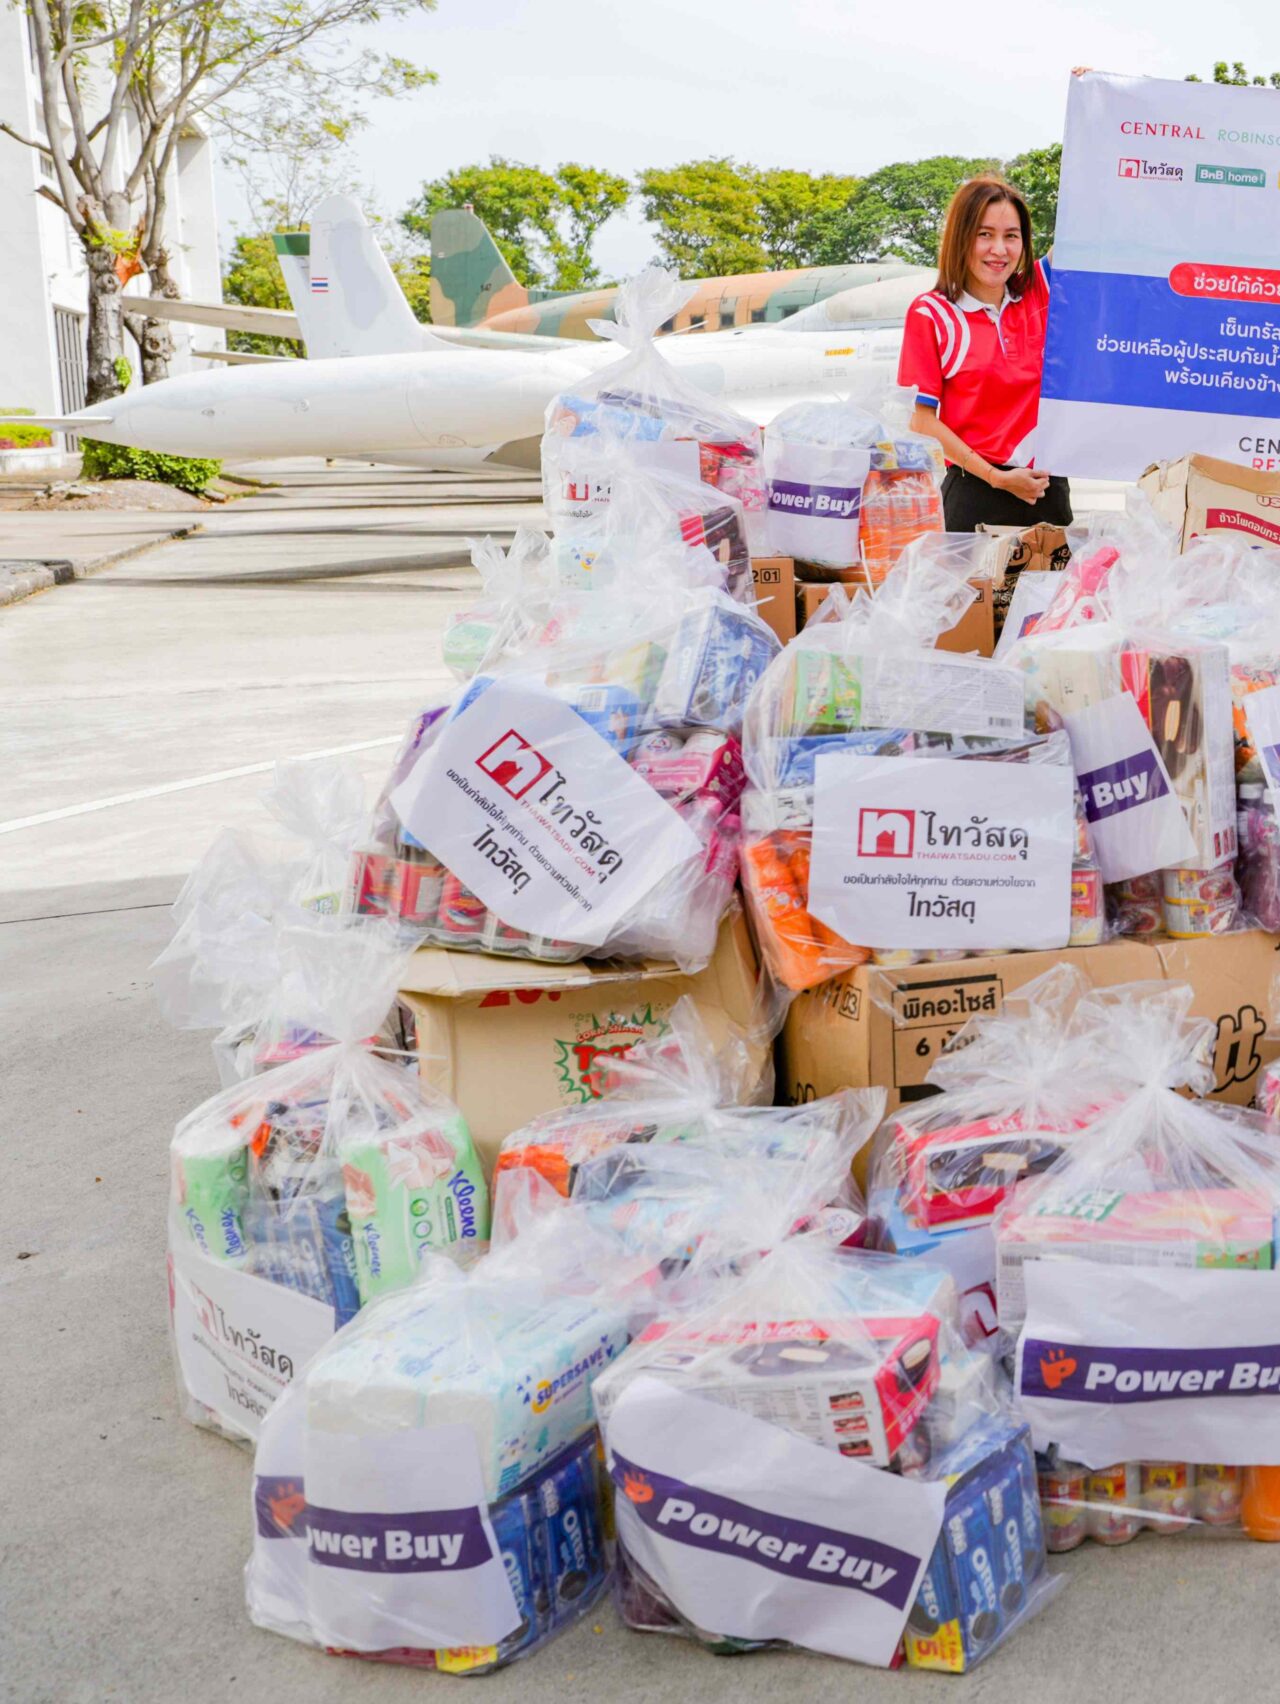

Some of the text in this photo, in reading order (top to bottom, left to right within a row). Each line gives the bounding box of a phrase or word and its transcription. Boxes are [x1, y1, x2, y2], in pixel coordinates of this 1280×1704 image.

[1120, 121, 1205, 140] CENTRAL
[1141, 160, 1183, 182] ไทวัสดุ
[1200, 168, 1224, 180] BnB
[815, 494, 856, 518] Buy
[763, 568, 778, 582] 01
[1092, 770, 1149, 809] Buy
[538, 770, 624, 885] ไทวัสดุ
[920, 809, 1030, 860] ไทวัสดุ
[473, 823, 533, 895] ไทวัสดุ
[916, 851, 1017, 862] THAIWATSADU.COM
[843, 873, 1036, 888] ขอเป็นกำลังใจให้ทุกท่าน ด้วยความห่วงใยจาก
[907, 891, 976, 924] ไทวัสดุ
[902, 986, 997, 1020] พิคอะไซส์
[915, 1037, 931, 1056] 6
[535, 1347, 605, 1406] SUPERSAVE
[1083, 1362, 1225, 1393] Power
[385, 1529, 464, 1567] Buy
[563, 1509, 585, 1570] OREO
[656, 1496, 899, 1591] Power Buy
[1005, 1519, 1023, 1581] OREO
[972, 1547, 996, 1610] OREO
